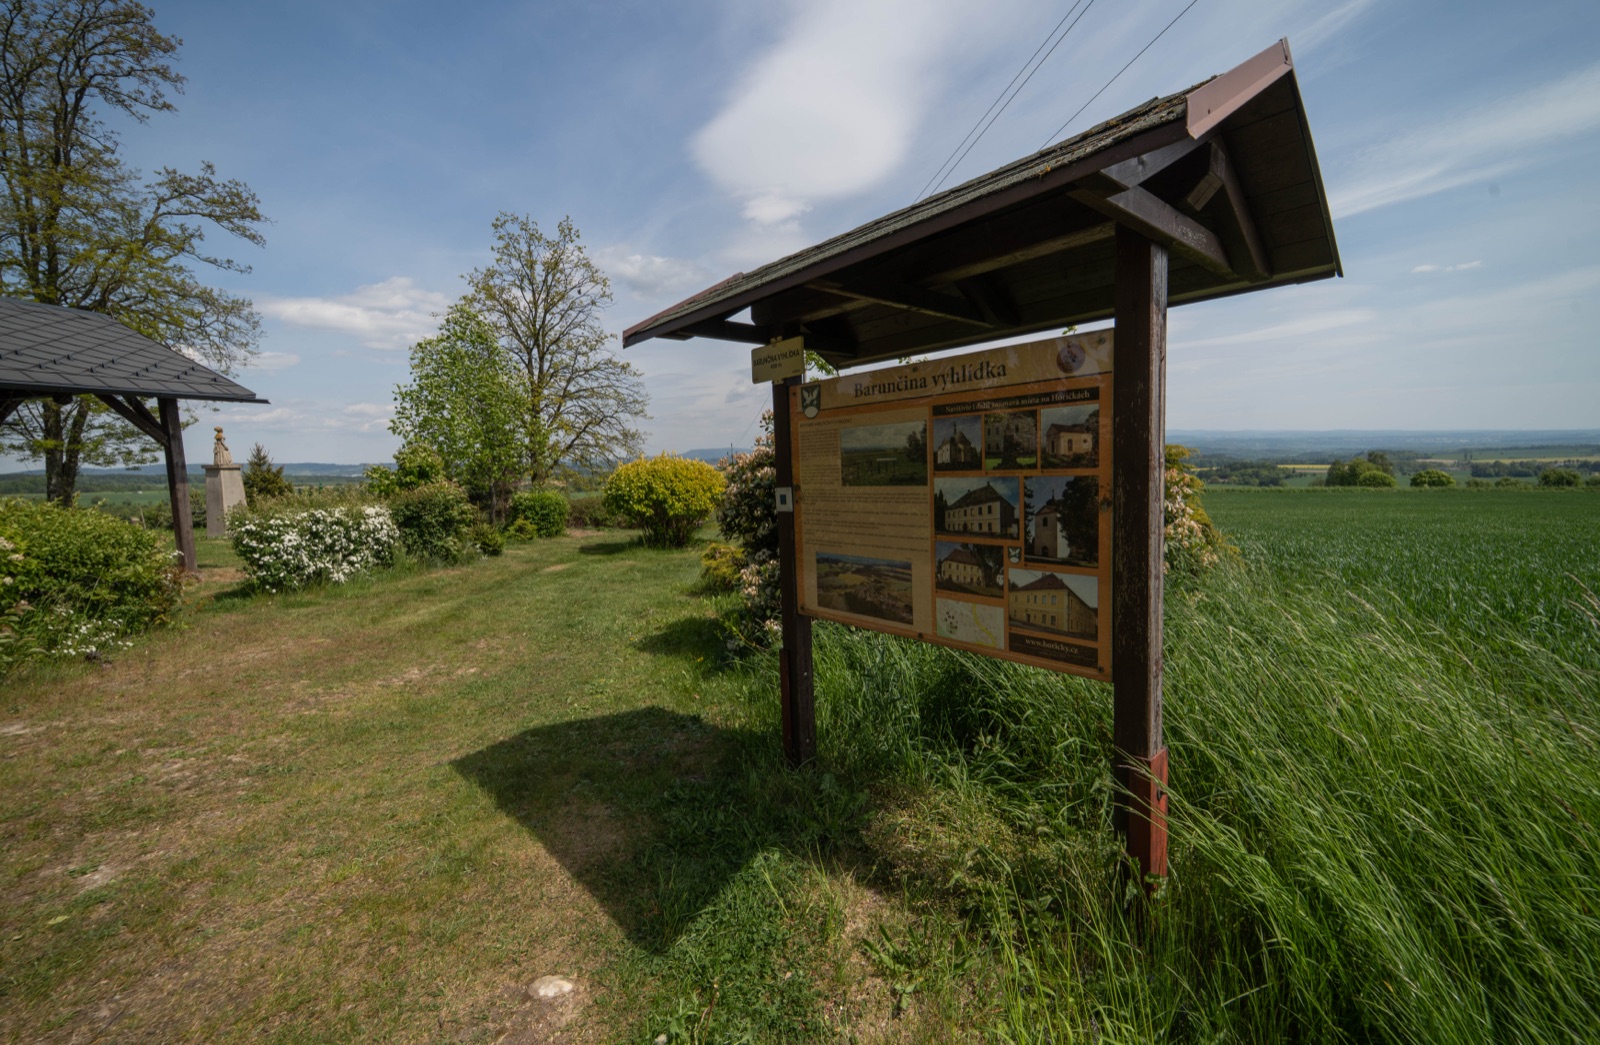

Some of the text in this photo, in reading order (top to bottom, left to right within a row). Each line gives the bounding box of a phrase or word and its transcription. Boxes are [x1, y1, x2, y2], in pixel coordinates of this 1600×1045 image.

[854, 360, 1007, 398] Barunčina vyhlídka
[1041, 395, 1050, 403] na
[1025, 638, 1078, 654] www.horicky.cz
